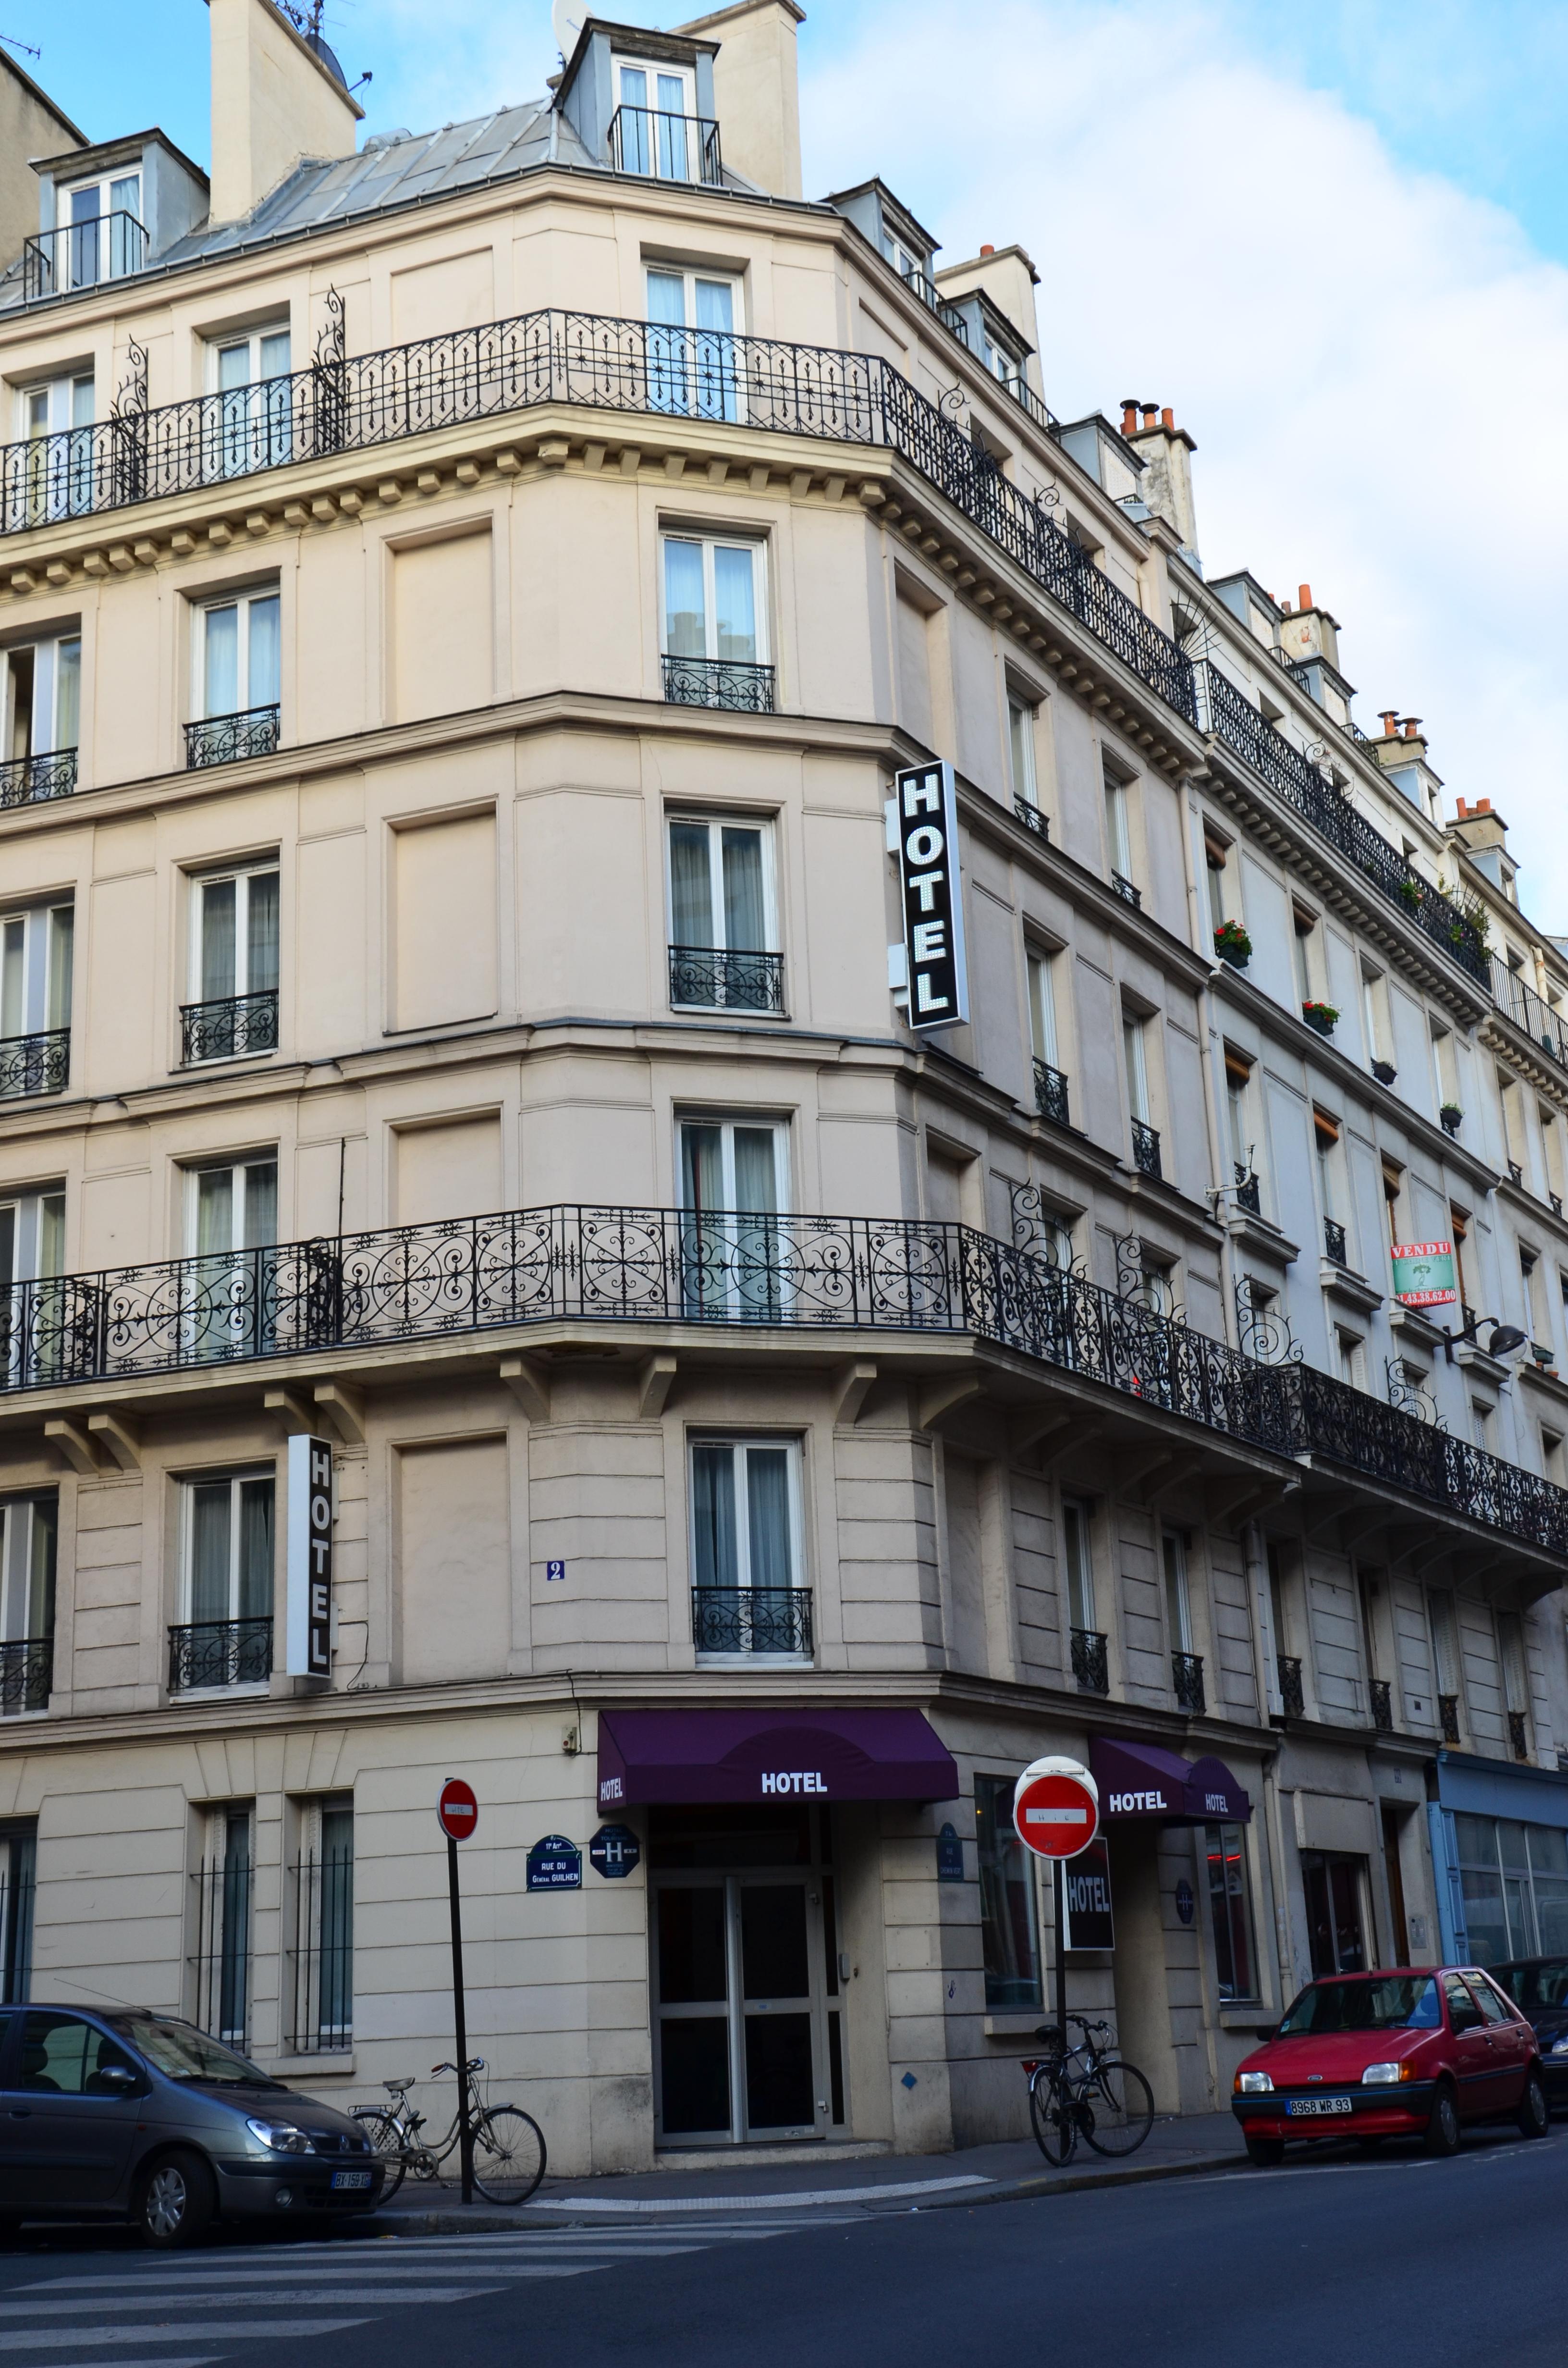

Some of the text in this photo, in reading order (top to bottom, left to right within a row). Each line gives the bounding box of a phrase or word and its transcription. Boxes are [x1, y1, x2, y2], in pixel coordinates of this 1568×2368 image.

[904, 774, 948, 1012] HOTEL
[1392, 1243, 1448, 1258] VENDU
[312, 1450, 330, 1665] HOTEL
[551, 1562, 560, 1579] 2
[600, 1777, 623, 1801] HOTEL
[762, 1773, 827, 1793] HOTEL
[1110, 1791, 1167, 1812] HOTEL
[1205, 1794, 1228, 1813] HOTEL
[606, 1842, 623, 1862] H
[1068, 1876, 1110, 1912] HOTEL
[1182, 1894, 1188, 1911] H
[1291, 2099, 1349, 2113] 8968 WR 93
